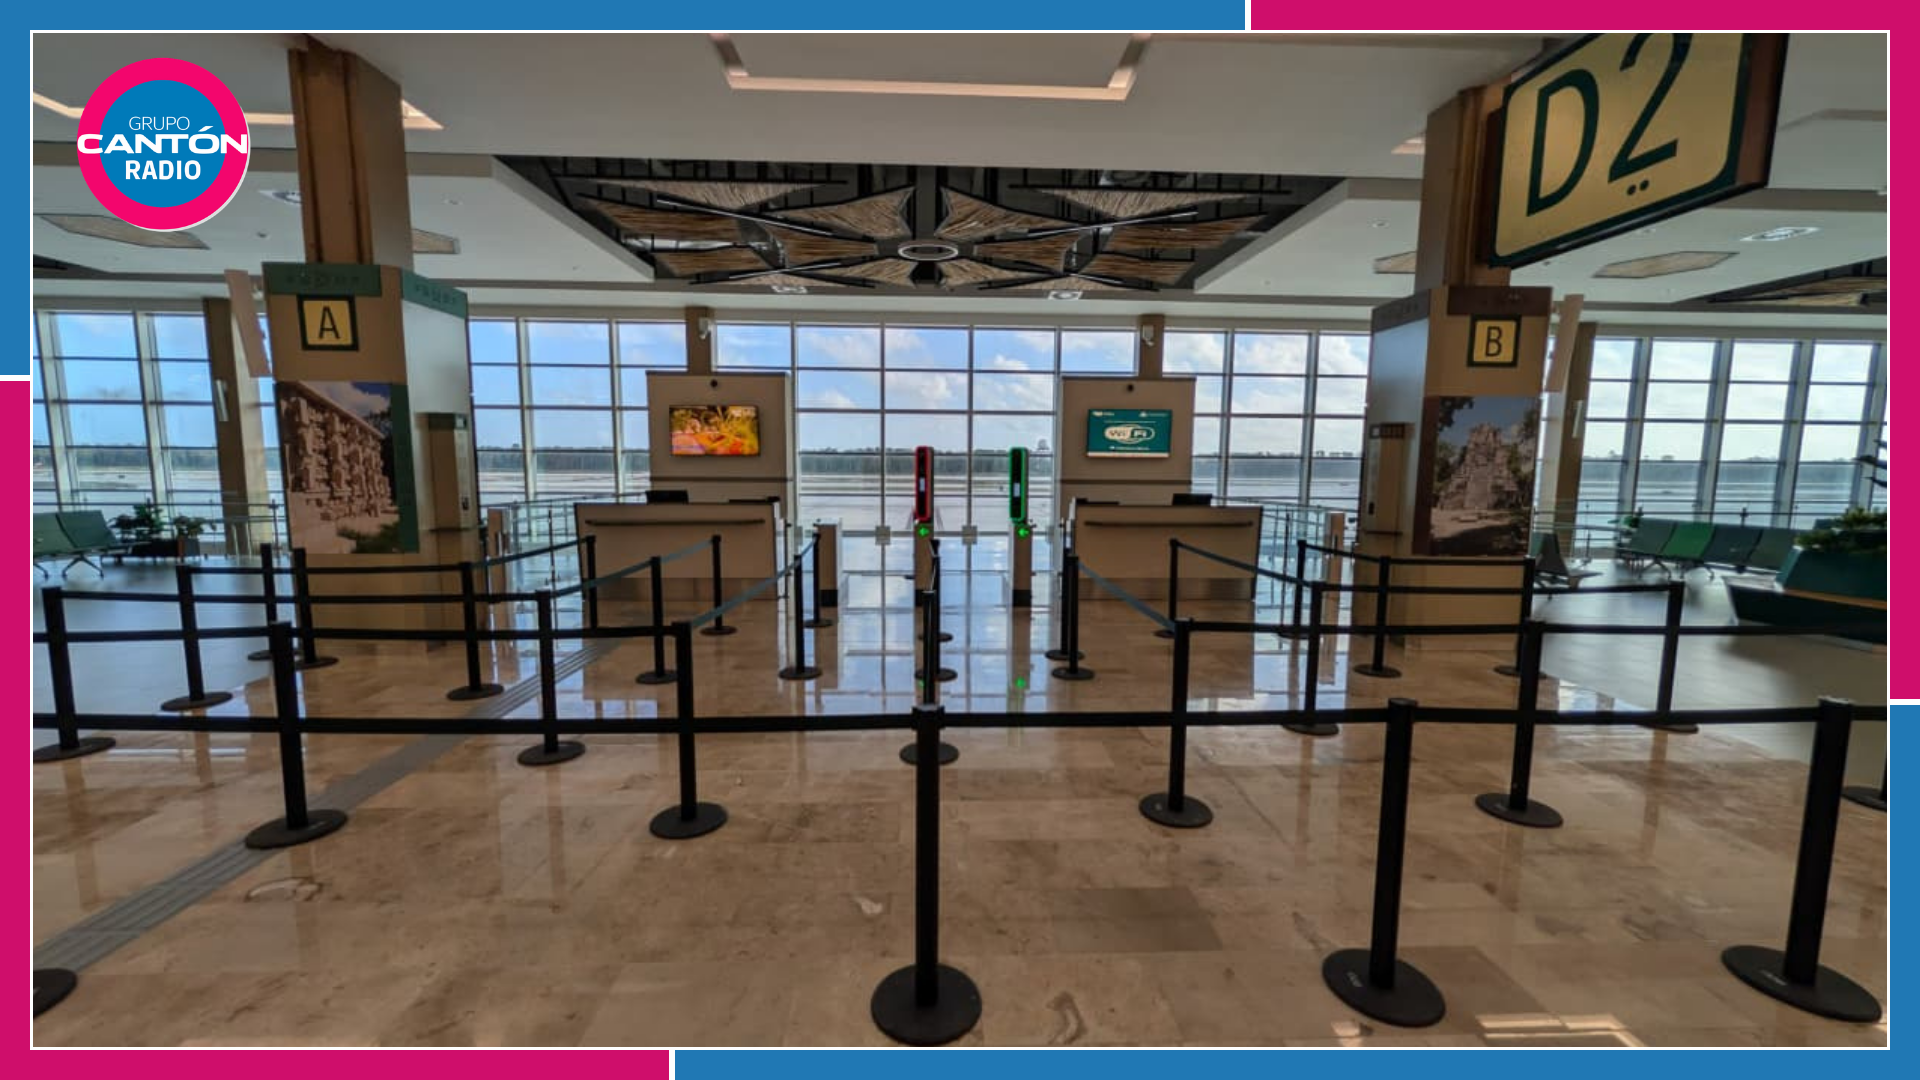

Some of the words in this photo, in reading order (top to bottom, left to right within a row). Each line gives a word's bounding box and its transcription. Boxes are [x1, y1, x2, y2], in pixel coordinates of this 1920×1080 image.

[1526, 33, 1693, 217] D2
[318, 306, 341, 339] A
[1484, 326, 1503, 357] B
